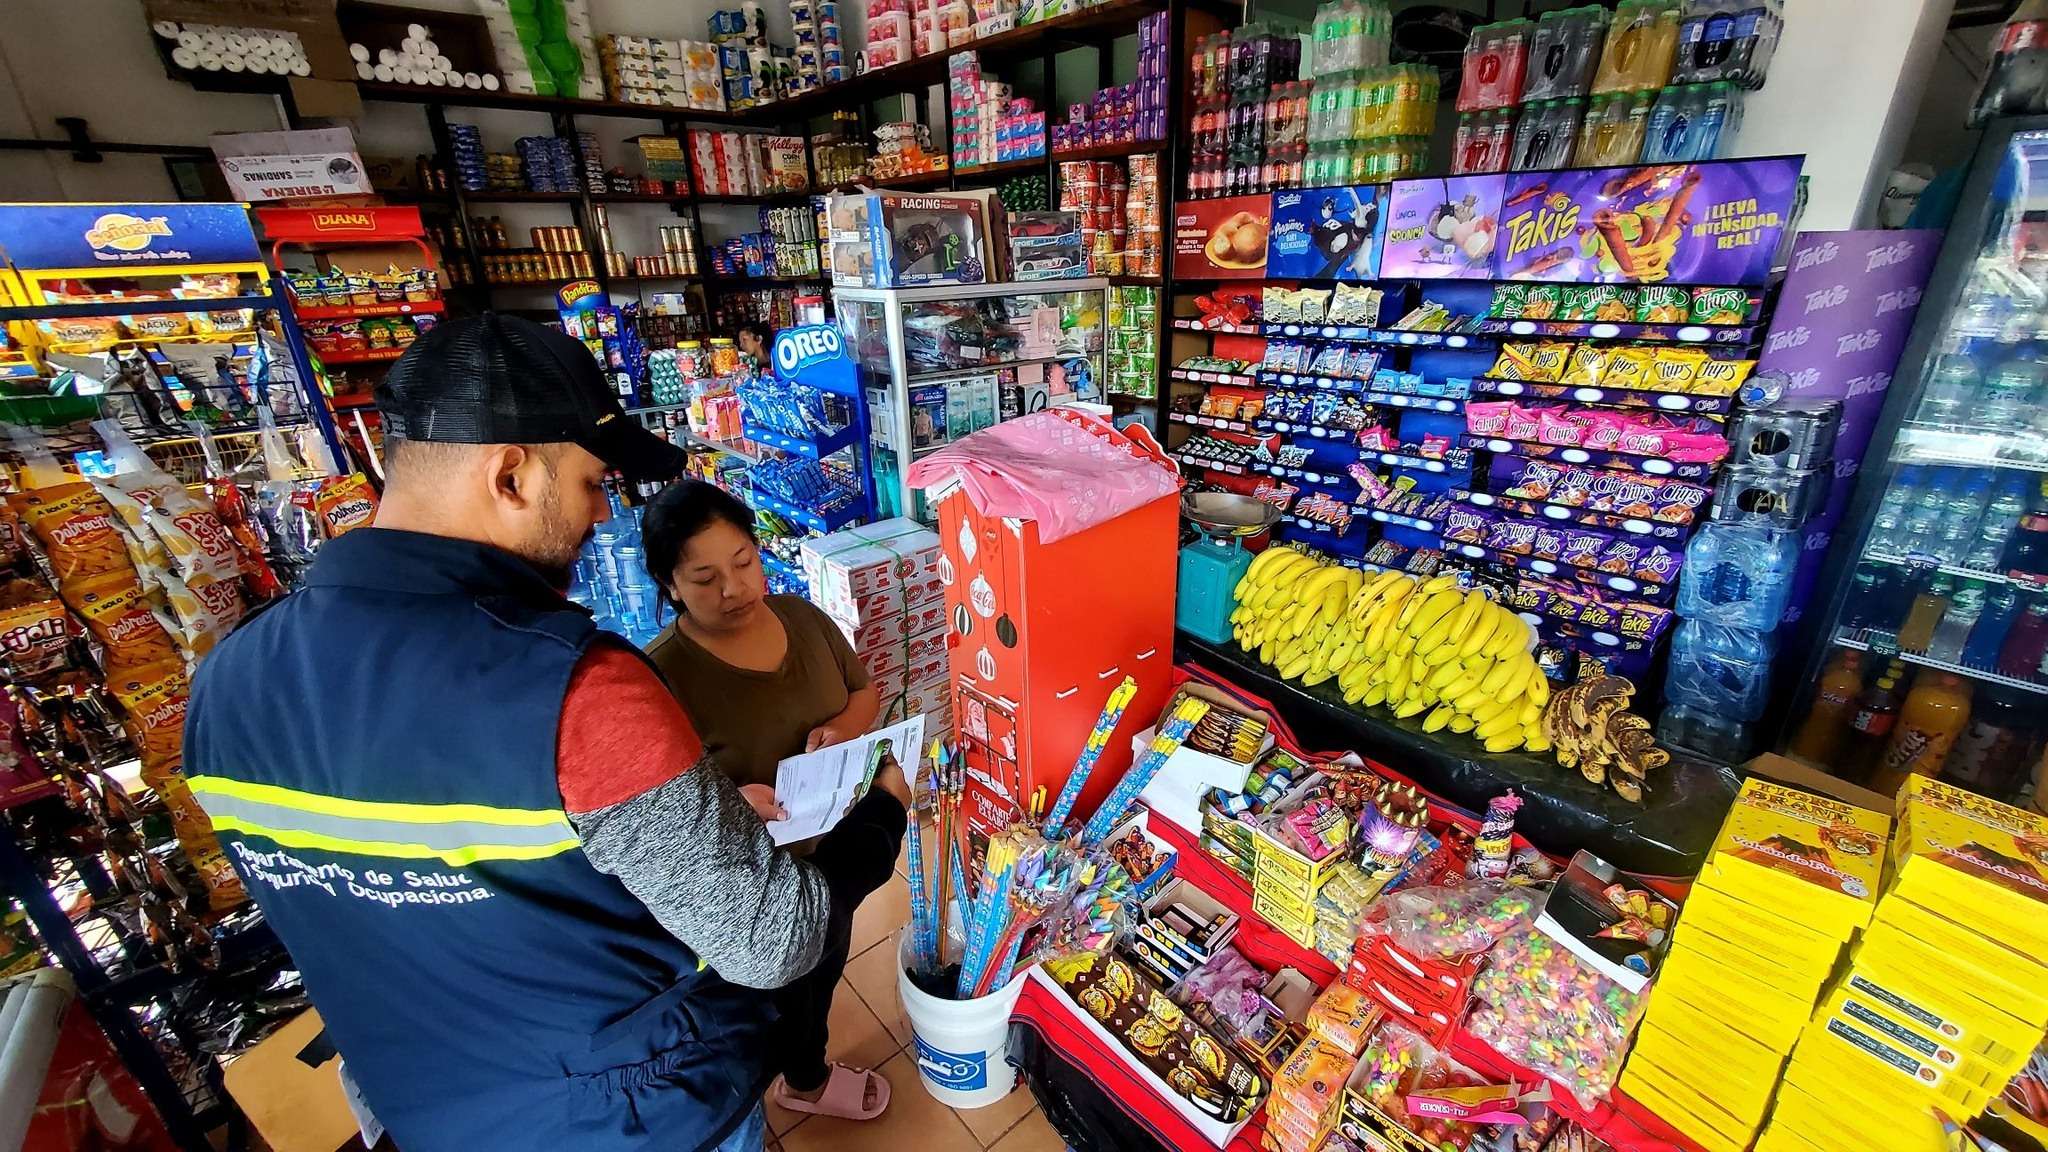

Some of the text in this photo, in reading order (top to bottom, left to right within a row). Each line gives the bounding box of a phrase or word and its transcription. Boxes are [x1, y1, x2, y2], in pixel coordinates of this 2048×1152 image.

[769, 139, 804, 154] Kellogg
[242, 170, 294, 182] SARDINAS
[901, 198, 941, 210] RACING
[319, 213, 371, 226] DIANA
[1506, 195, 1582, 262] Takis
[1692, 212, 1779, 238] INTENSIDAD
[1796, 240, 1914, 273] Takis Takis
[562, 282, 600, 304] Panditas
[1804, 284, 1922, 317] Takis Takis
[777, 330, 840, 371] OREO
[1768, 326, 1882, 358] Takis Takis
[1788, 367, 1892, 399] kis Takis
[327, 501, 375, 526] Dobrecitos
[49, 515, 109, 545] Dobrecit
[101, 597, 123, 609] SOLO
[1515, 591, 1540, 608] akis
[1551, 600, 1577, 618] akis
[107, 610, 154, 641] Dobreci
[1579, 606, 1609, 627] Takis
[1620, 613, 1652, 634] Takis
[0, 618, 65, 652] ijoli
[1577, 662, 1606, 680] Takis
[142, 685, 163, 698] SOLO
[143, 697, 189, 729] Dobrec
[1747, 789, 1857, 826] BRAND
[1755, 782, 1853, 815] TIGRE
[1924, 779, 2042, 826] TIGRE
[364, 869, 393, 886] de
[1807, 859, 1864, 885] Fuego
[348, 882, 495, 908] Ocupaciona
